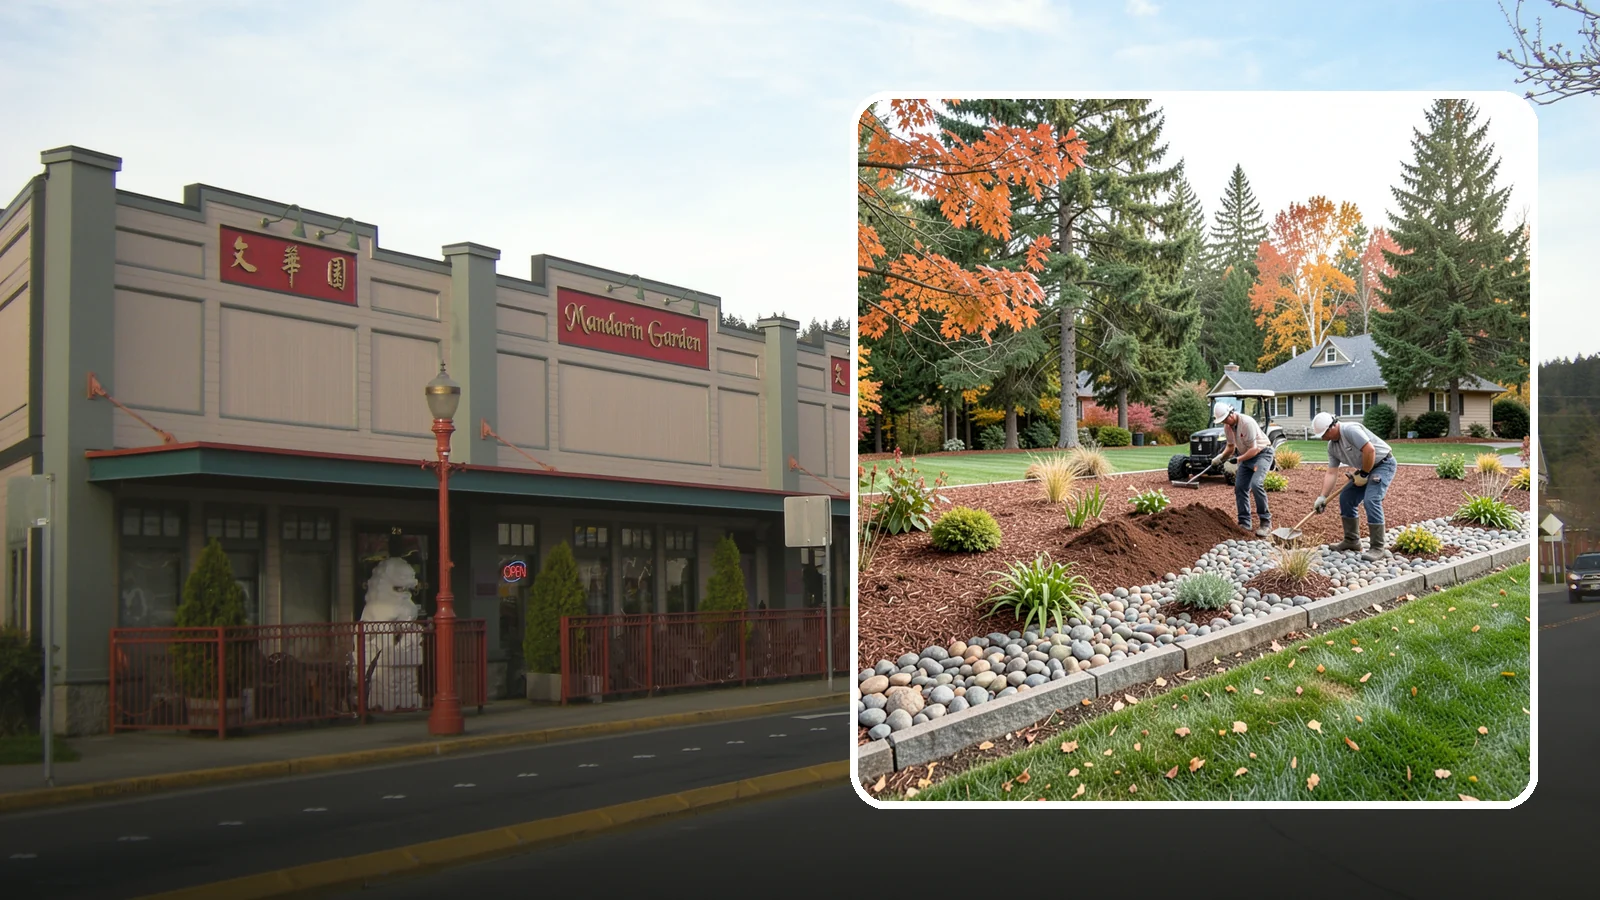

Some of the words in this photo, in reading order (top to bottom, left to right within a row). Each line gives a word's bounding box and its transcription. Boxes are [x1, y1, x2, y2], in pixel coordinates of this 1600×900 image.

[231, 235, 346, 291] 文華園
[564, 302, 644, 341] Mandarin
[648, 320, 702, 352] Garden
[503, 565, 527, 578] OPEN
